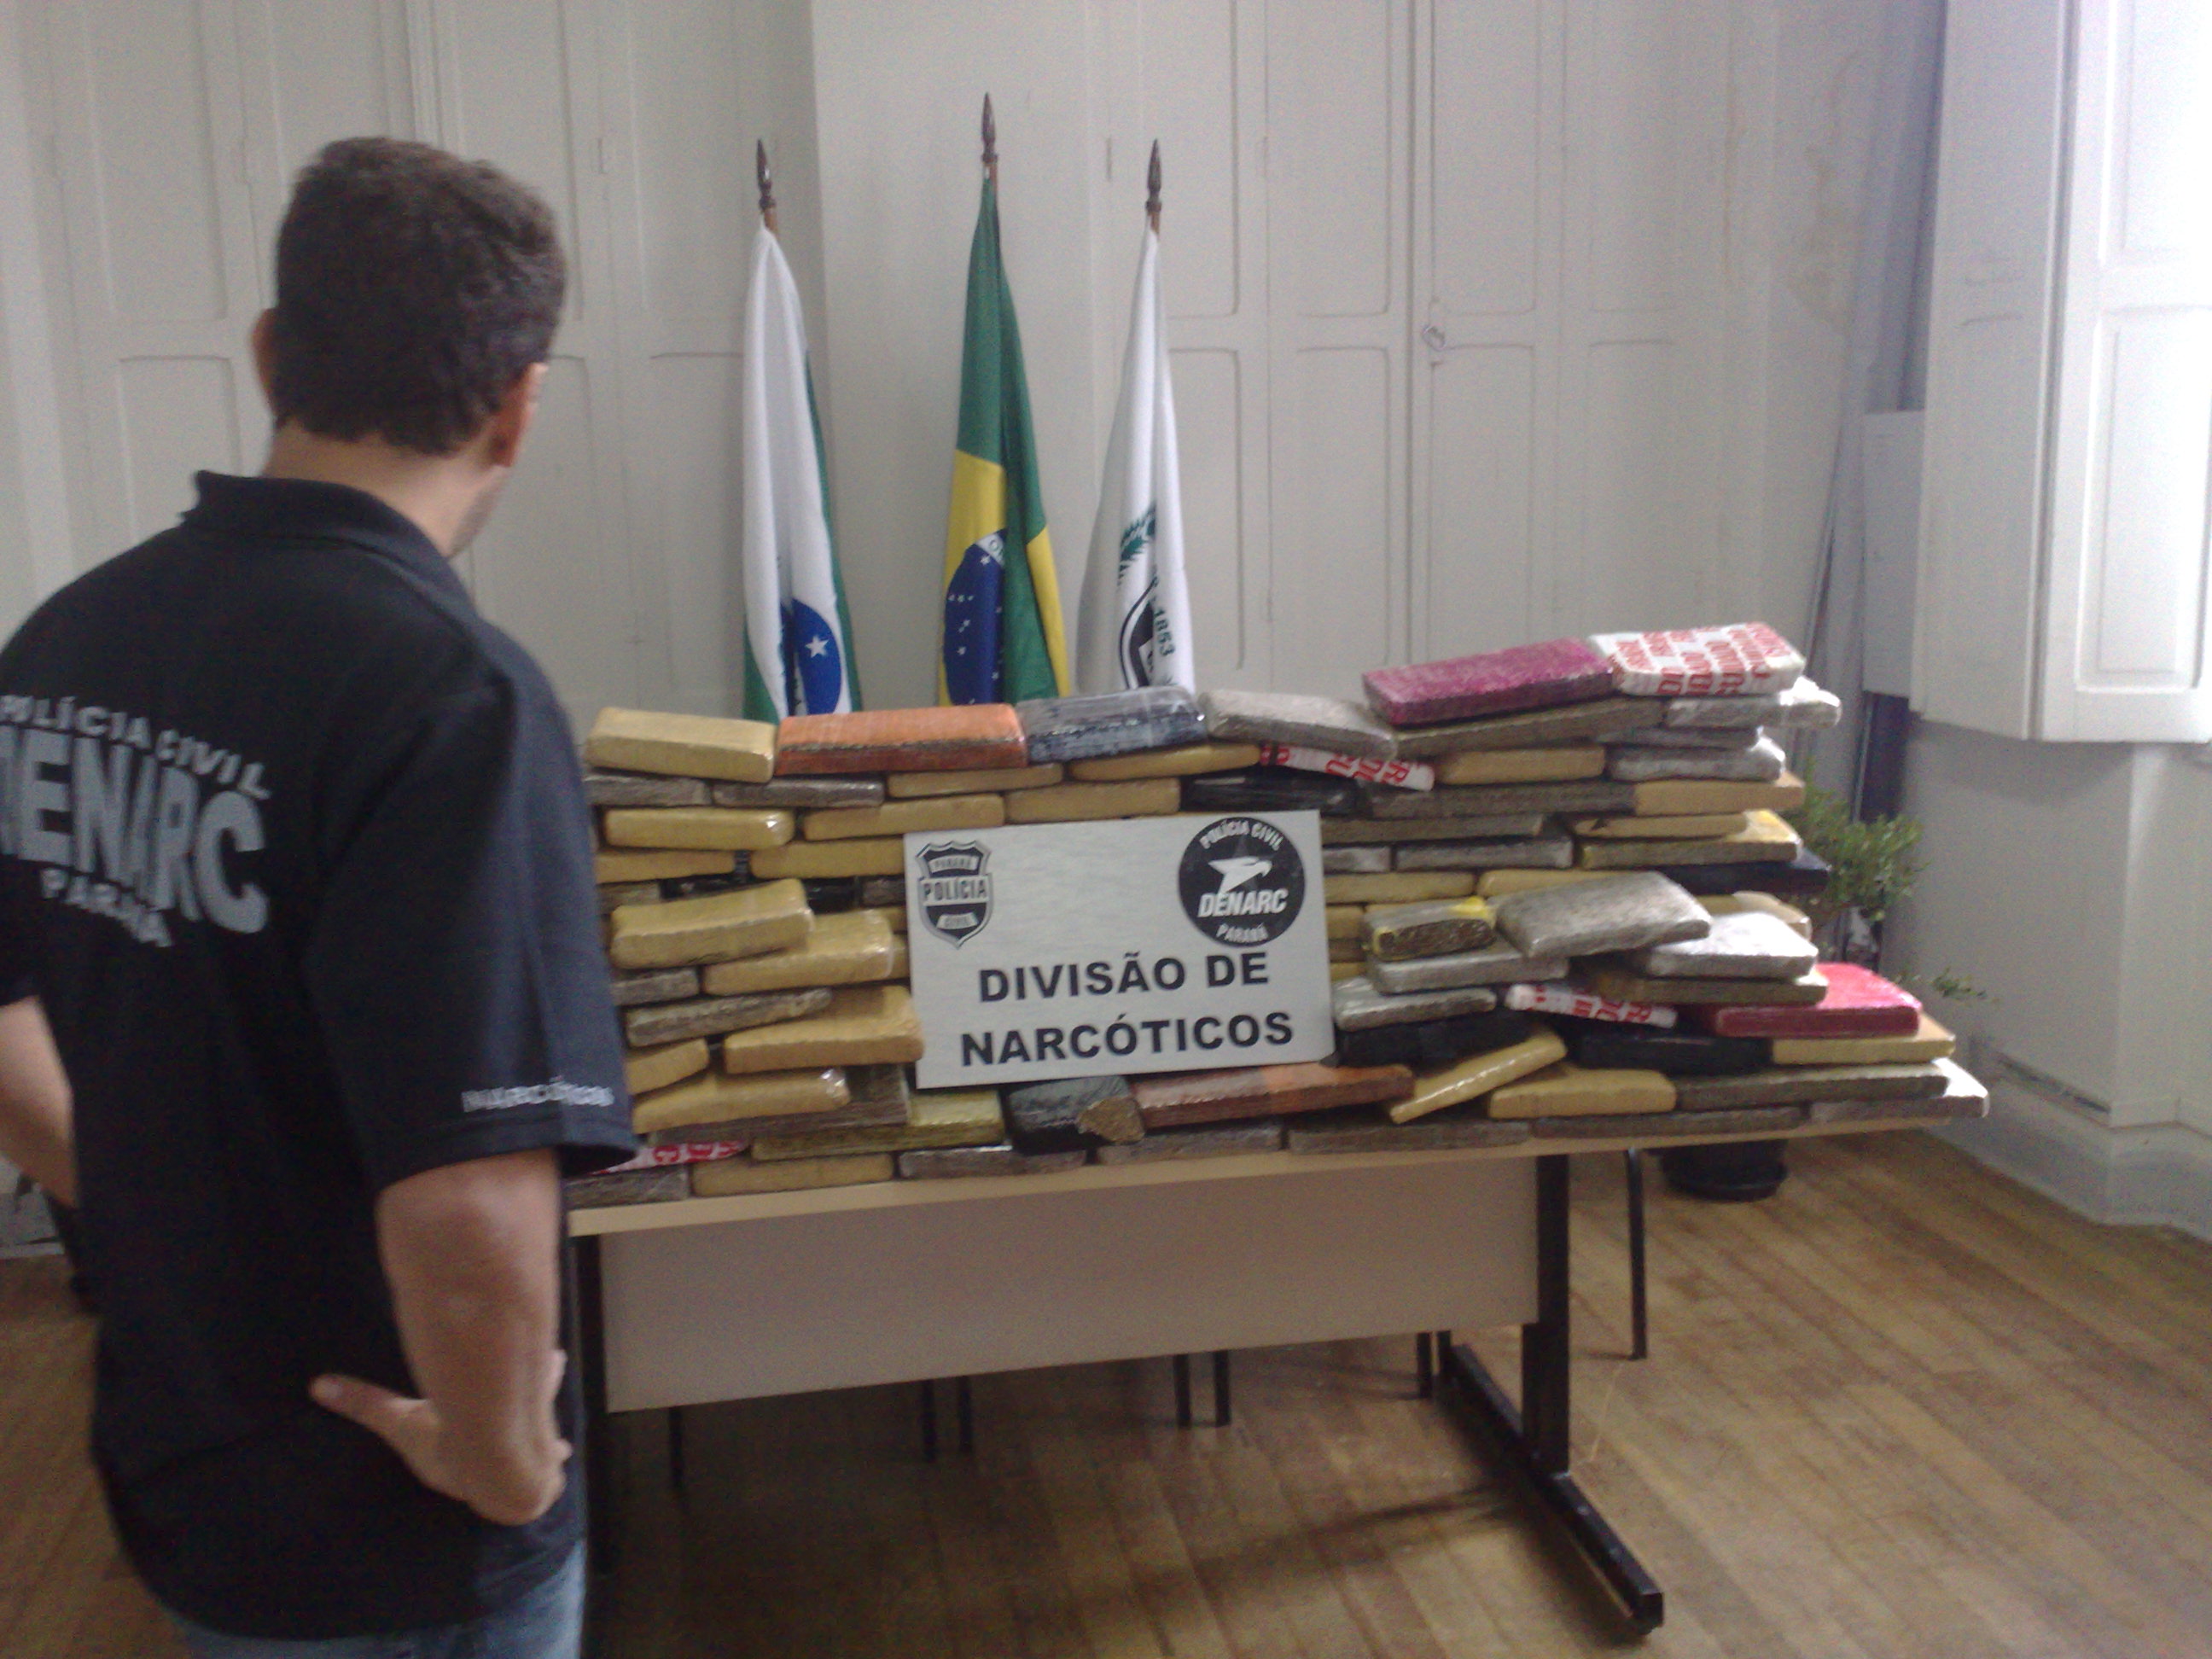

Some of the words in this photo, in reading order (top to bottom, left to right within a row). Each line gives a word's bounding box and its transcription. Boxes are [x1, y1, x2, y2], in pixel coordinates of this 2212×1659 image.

[1197, 888, 1289, 918] DENARC
[980, 951, 1185, 1004] DIVISÃO
[1205, 952, 1269, 987] DE
[961, 1012, 1294, 1067] NARCÓTICOS
